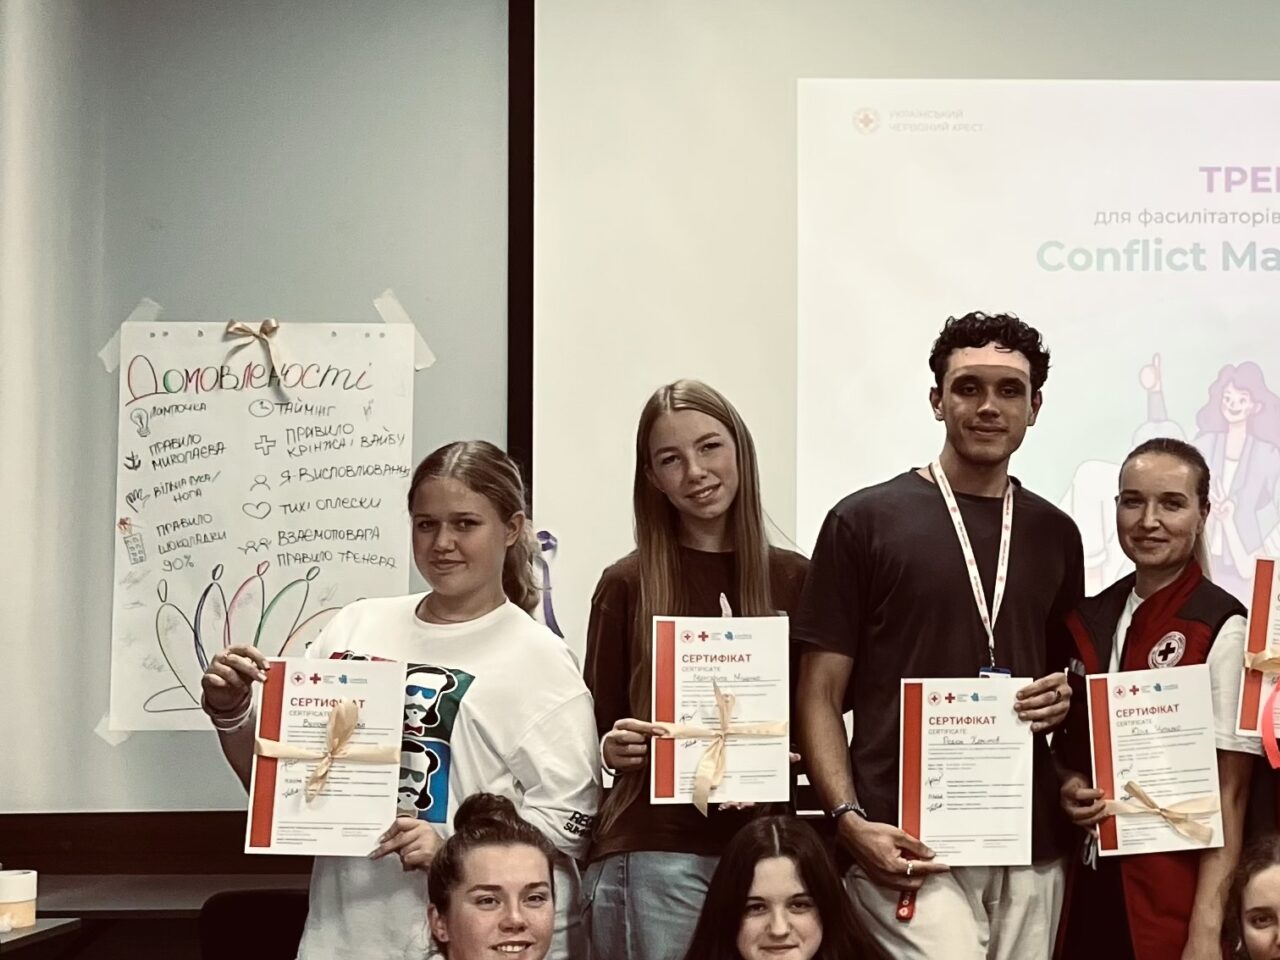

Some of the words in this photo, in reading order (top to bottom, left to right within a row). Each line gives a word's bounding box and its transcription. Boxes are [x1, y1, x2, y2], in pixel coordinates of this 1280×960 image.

[1094, 210, 1132, 226] для
[1036, 237, 1208, 272] Conflict
[286, 423, 355, 445] ПРАВИЛО
[149, 434, 202, 456] ПРАВИЛО
[156, 513, 213, 537] ПРАВИЛО
[682, 654, 752, 663] СЕРТИФІКАТ
[929, 716, 997, 725] СЕРТИФІКАТ
[1116, 704, 1180, 718] СЕРТИФІКАТ
